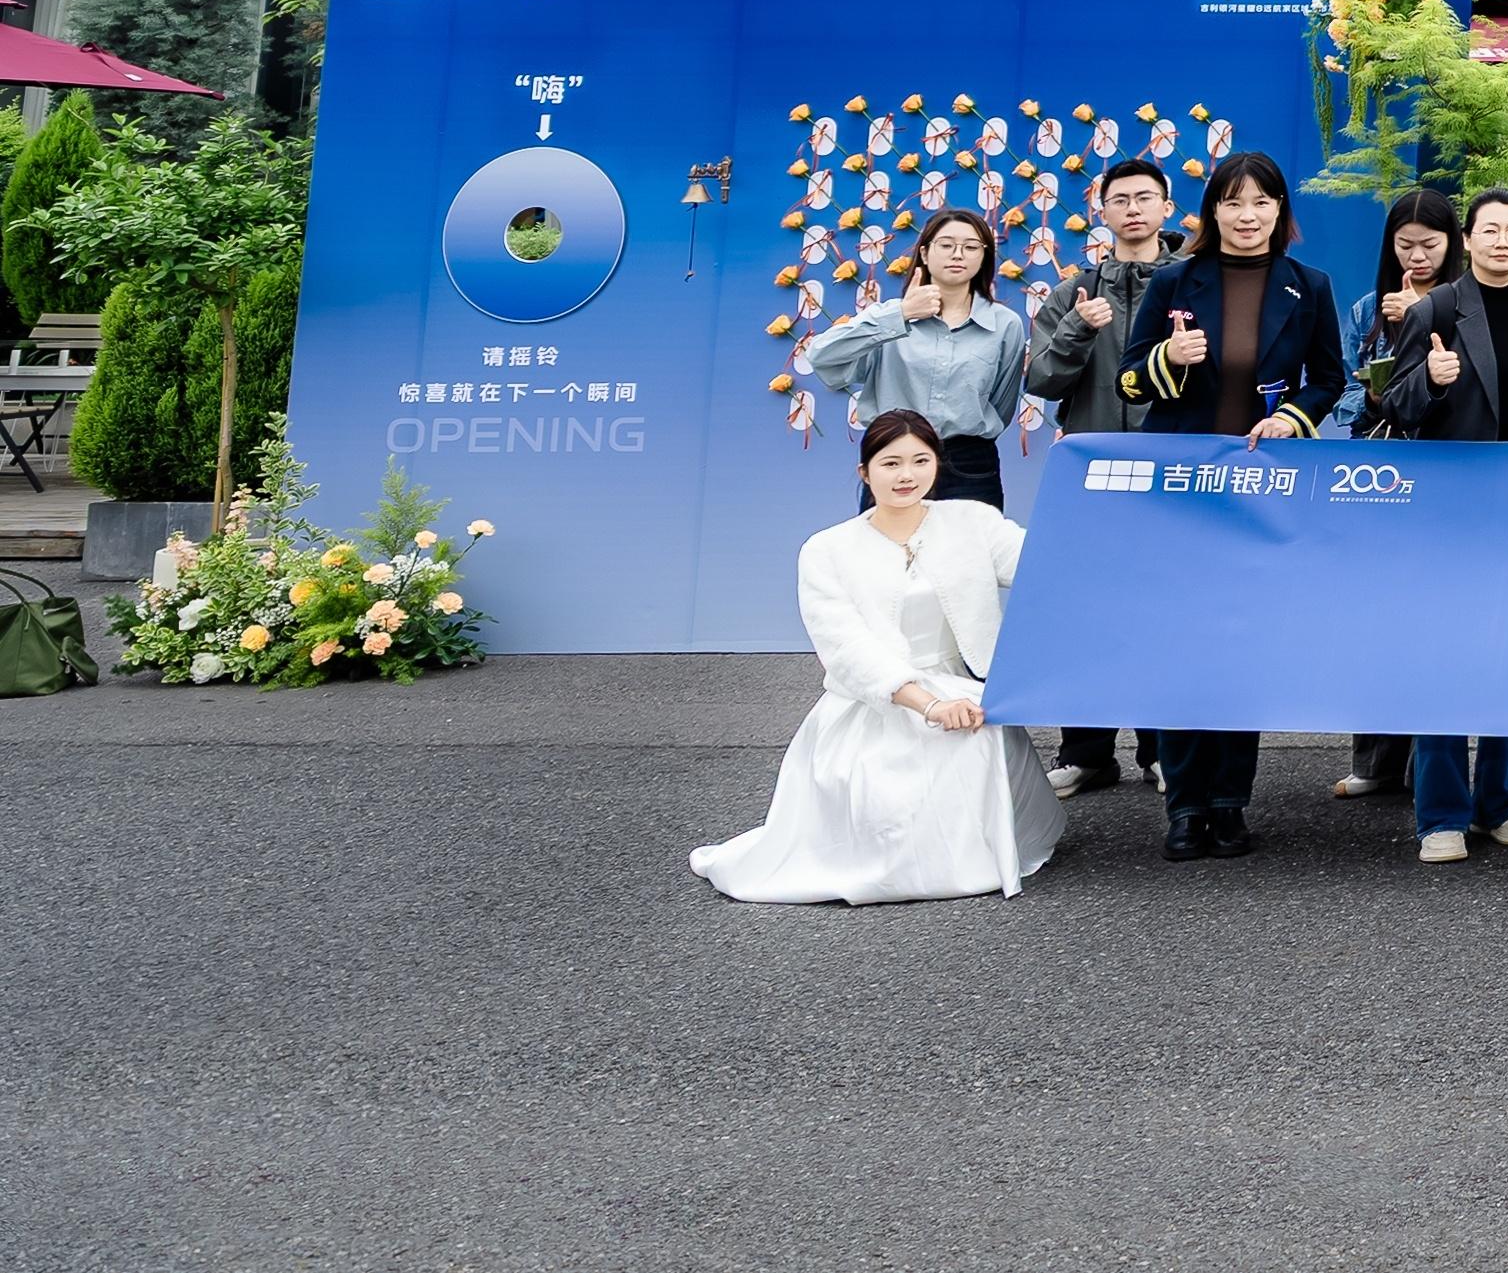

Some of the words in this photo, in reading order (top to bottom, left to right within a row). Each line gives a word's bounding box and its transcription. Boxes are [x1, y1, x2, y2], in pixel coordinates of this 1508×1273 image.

[482, 346, 560, 367] 请摇铃
[398, 382, 637, 404] 惊喜就在下一个瞬间
[386, 417, 646, 454] OPENING
[1162, 464, 1299, 496] 吉利银河
[1330, 464, 1415, 495] 200万
